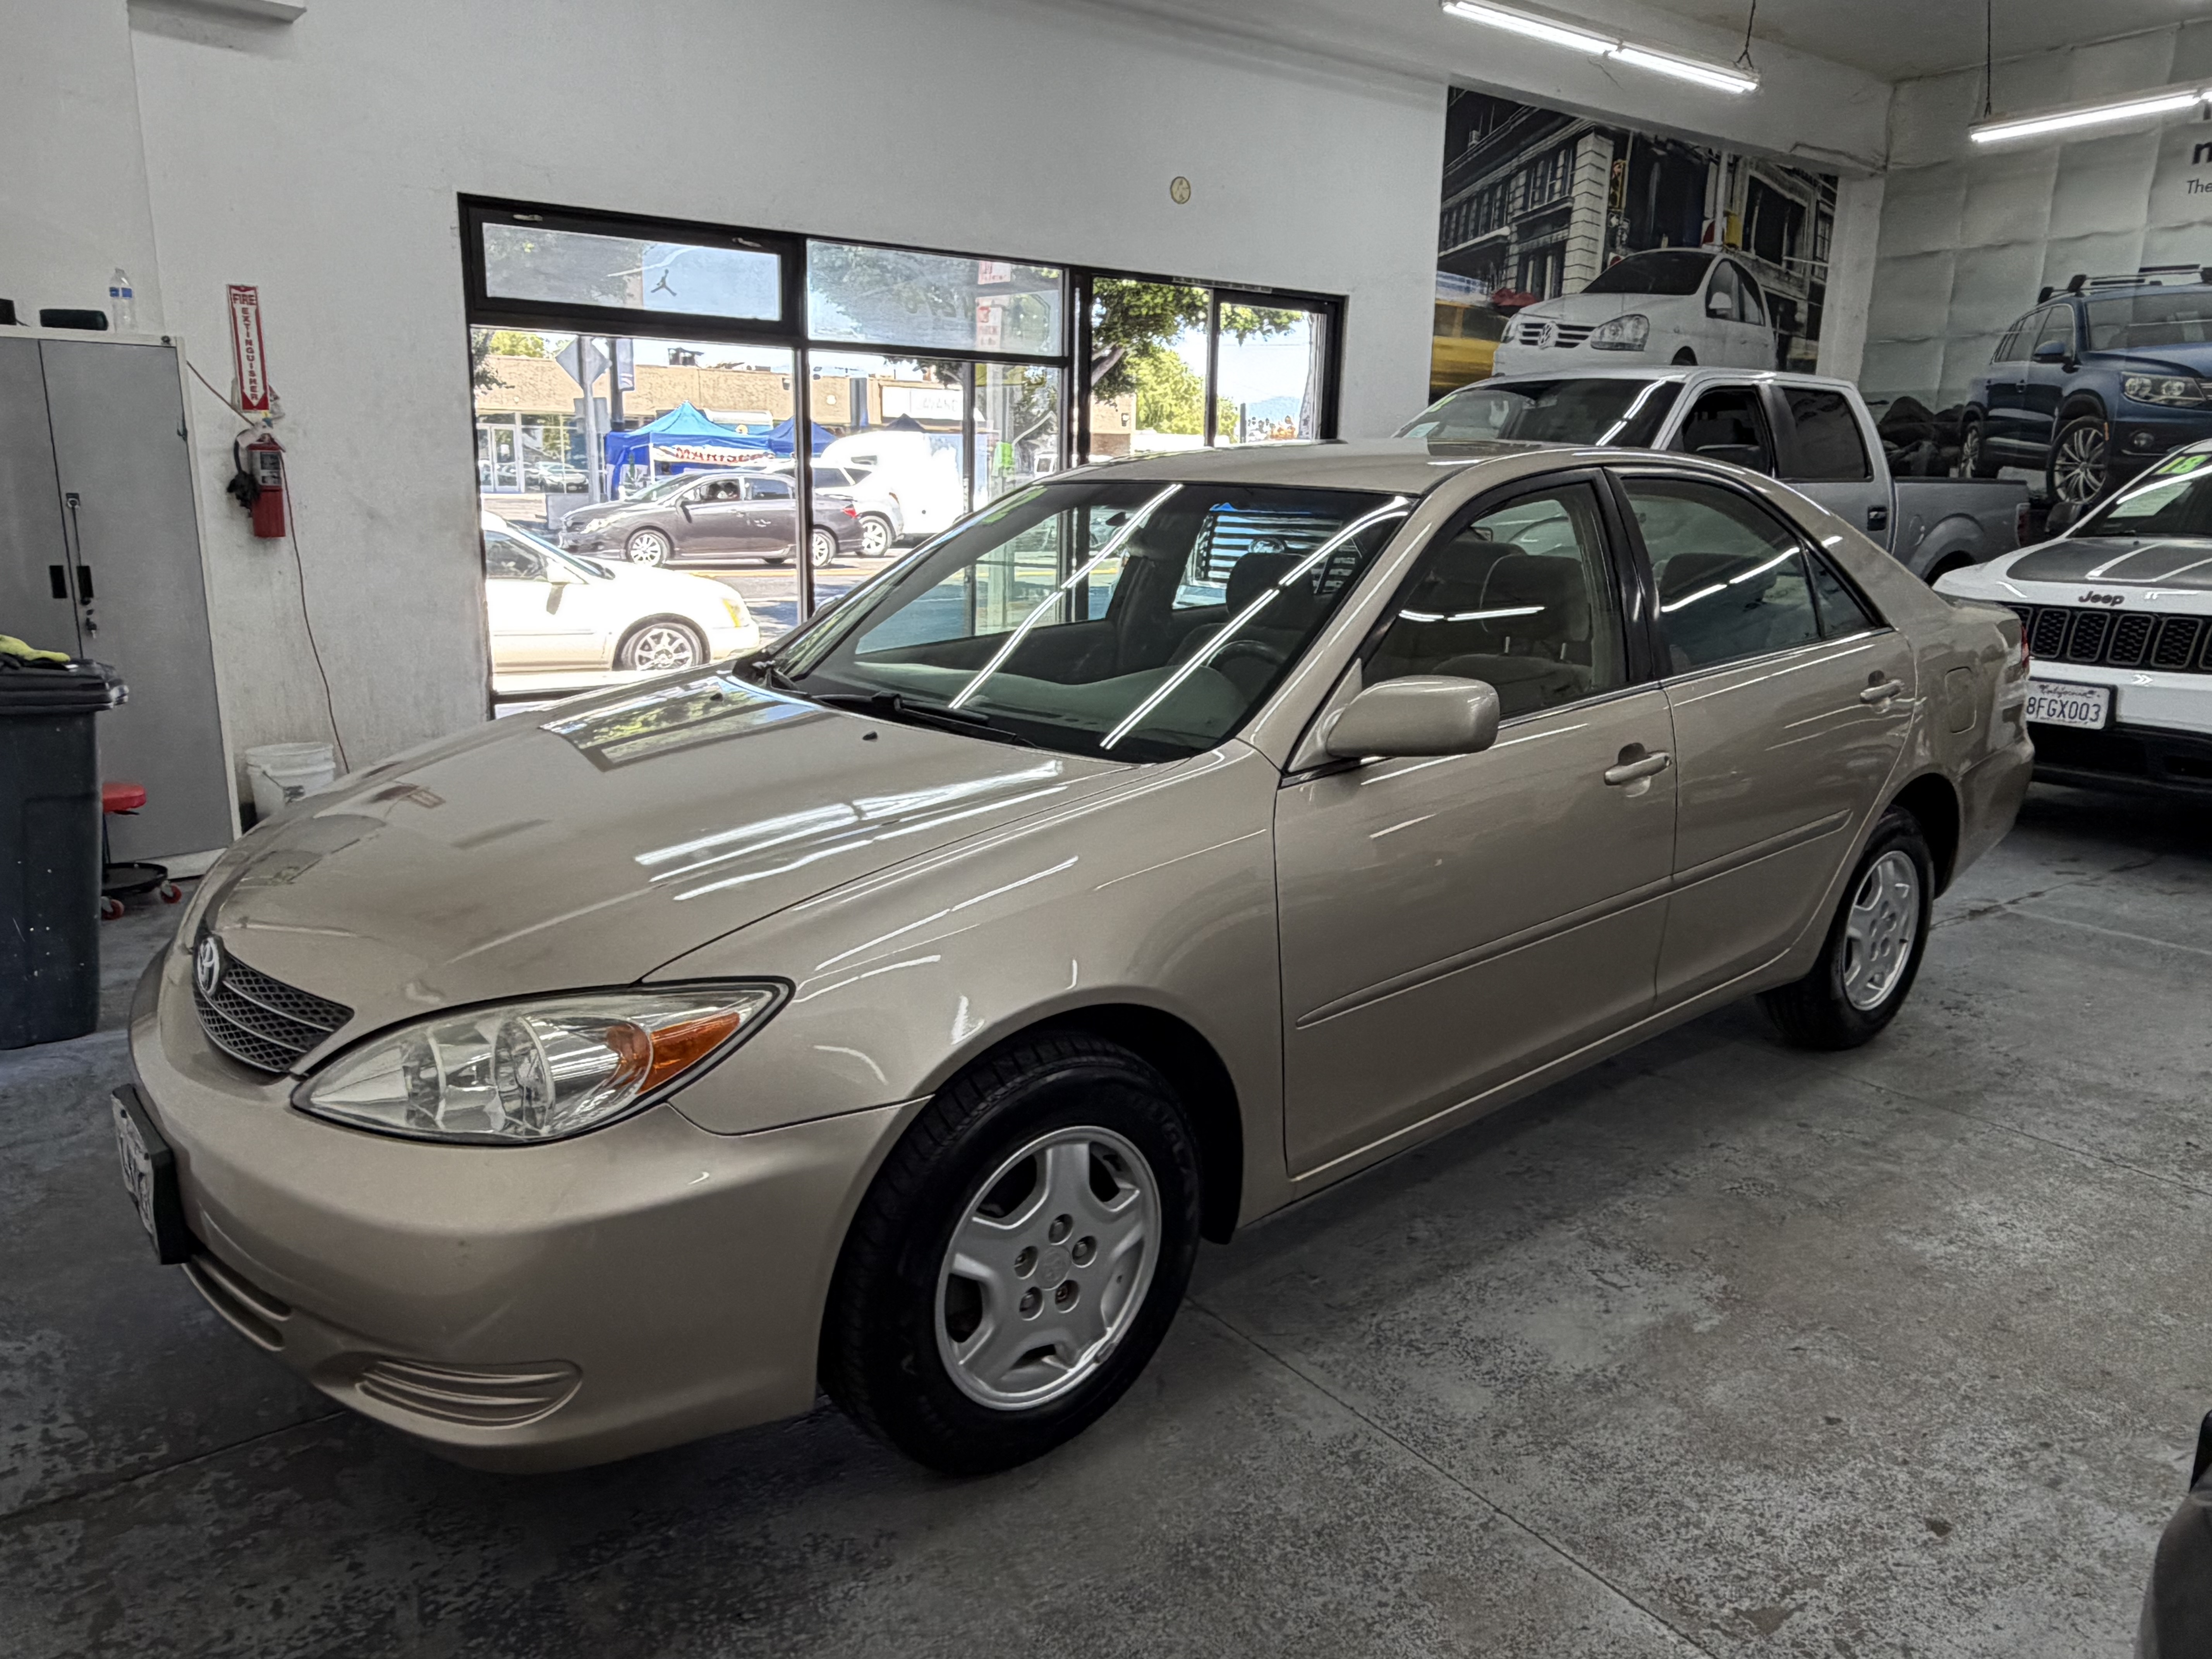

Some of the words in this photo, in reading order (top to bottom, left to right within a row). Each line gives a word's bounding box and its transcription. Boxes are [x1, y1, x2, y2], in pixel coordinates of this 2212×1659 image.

[232, 293, 257, 305] FIRE
[242, 308, 258, 400] EXTINGUISHER
[2078, 590, 2125, 606] Jeep
[2027, 696, 2101, 722] 8FGX003
